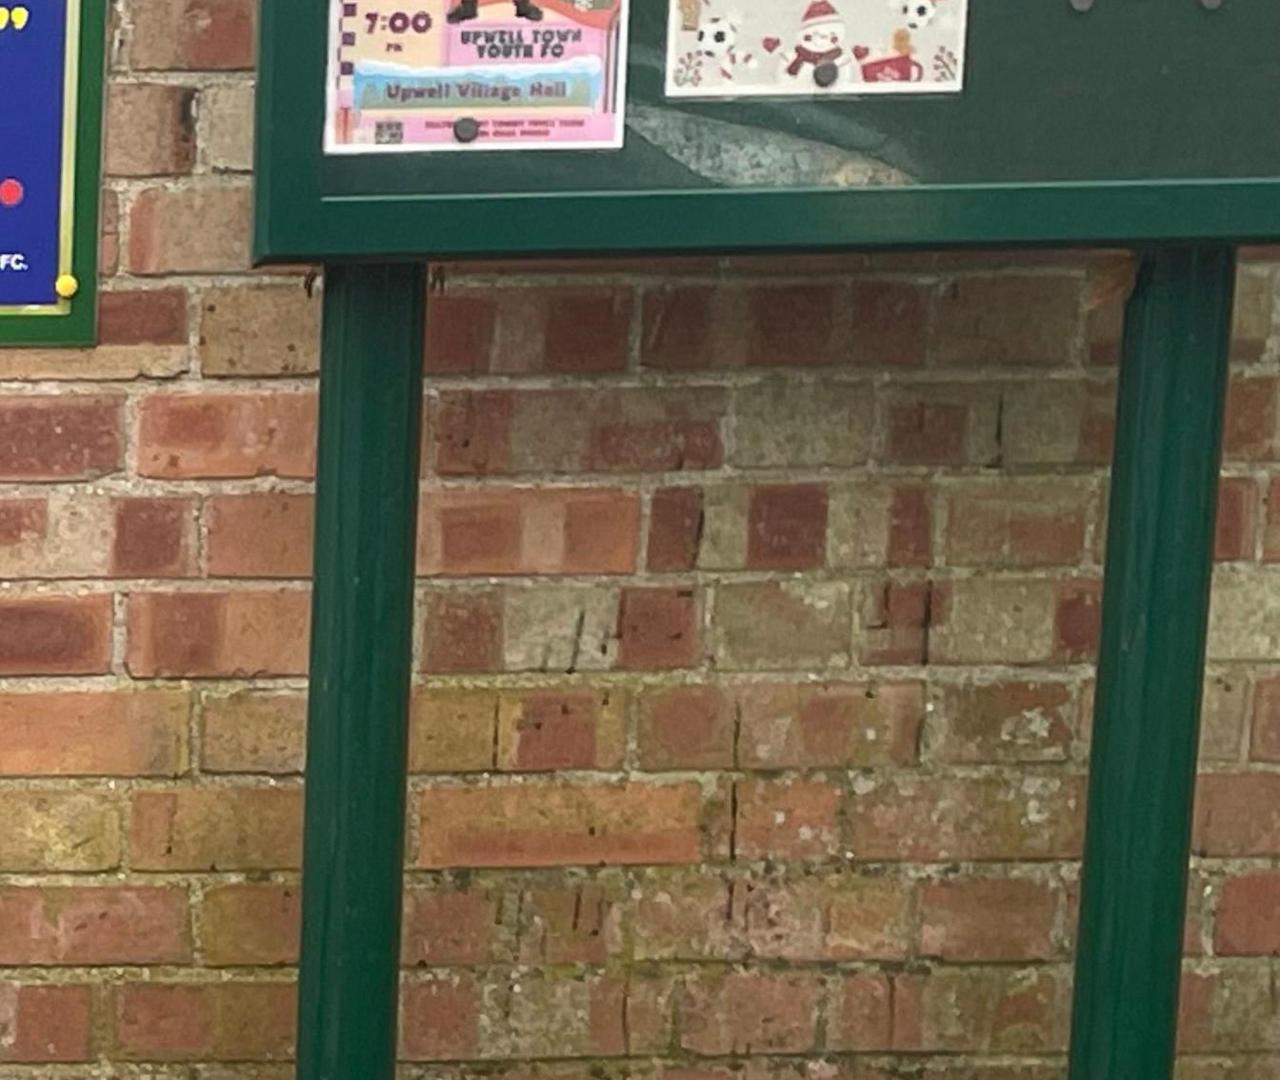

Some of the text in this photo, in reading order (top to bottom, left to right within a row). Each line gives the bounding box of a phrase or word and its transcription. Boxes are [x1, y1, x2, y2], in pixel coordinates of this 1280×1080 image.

[365, 10, 432, 34] 7:00
[460, 28, 582, 44] UPWELL TOWN
[477, 44, 564, 58] YOUTH FC
[386, 82, 567, 101] Upwell Village Hall
